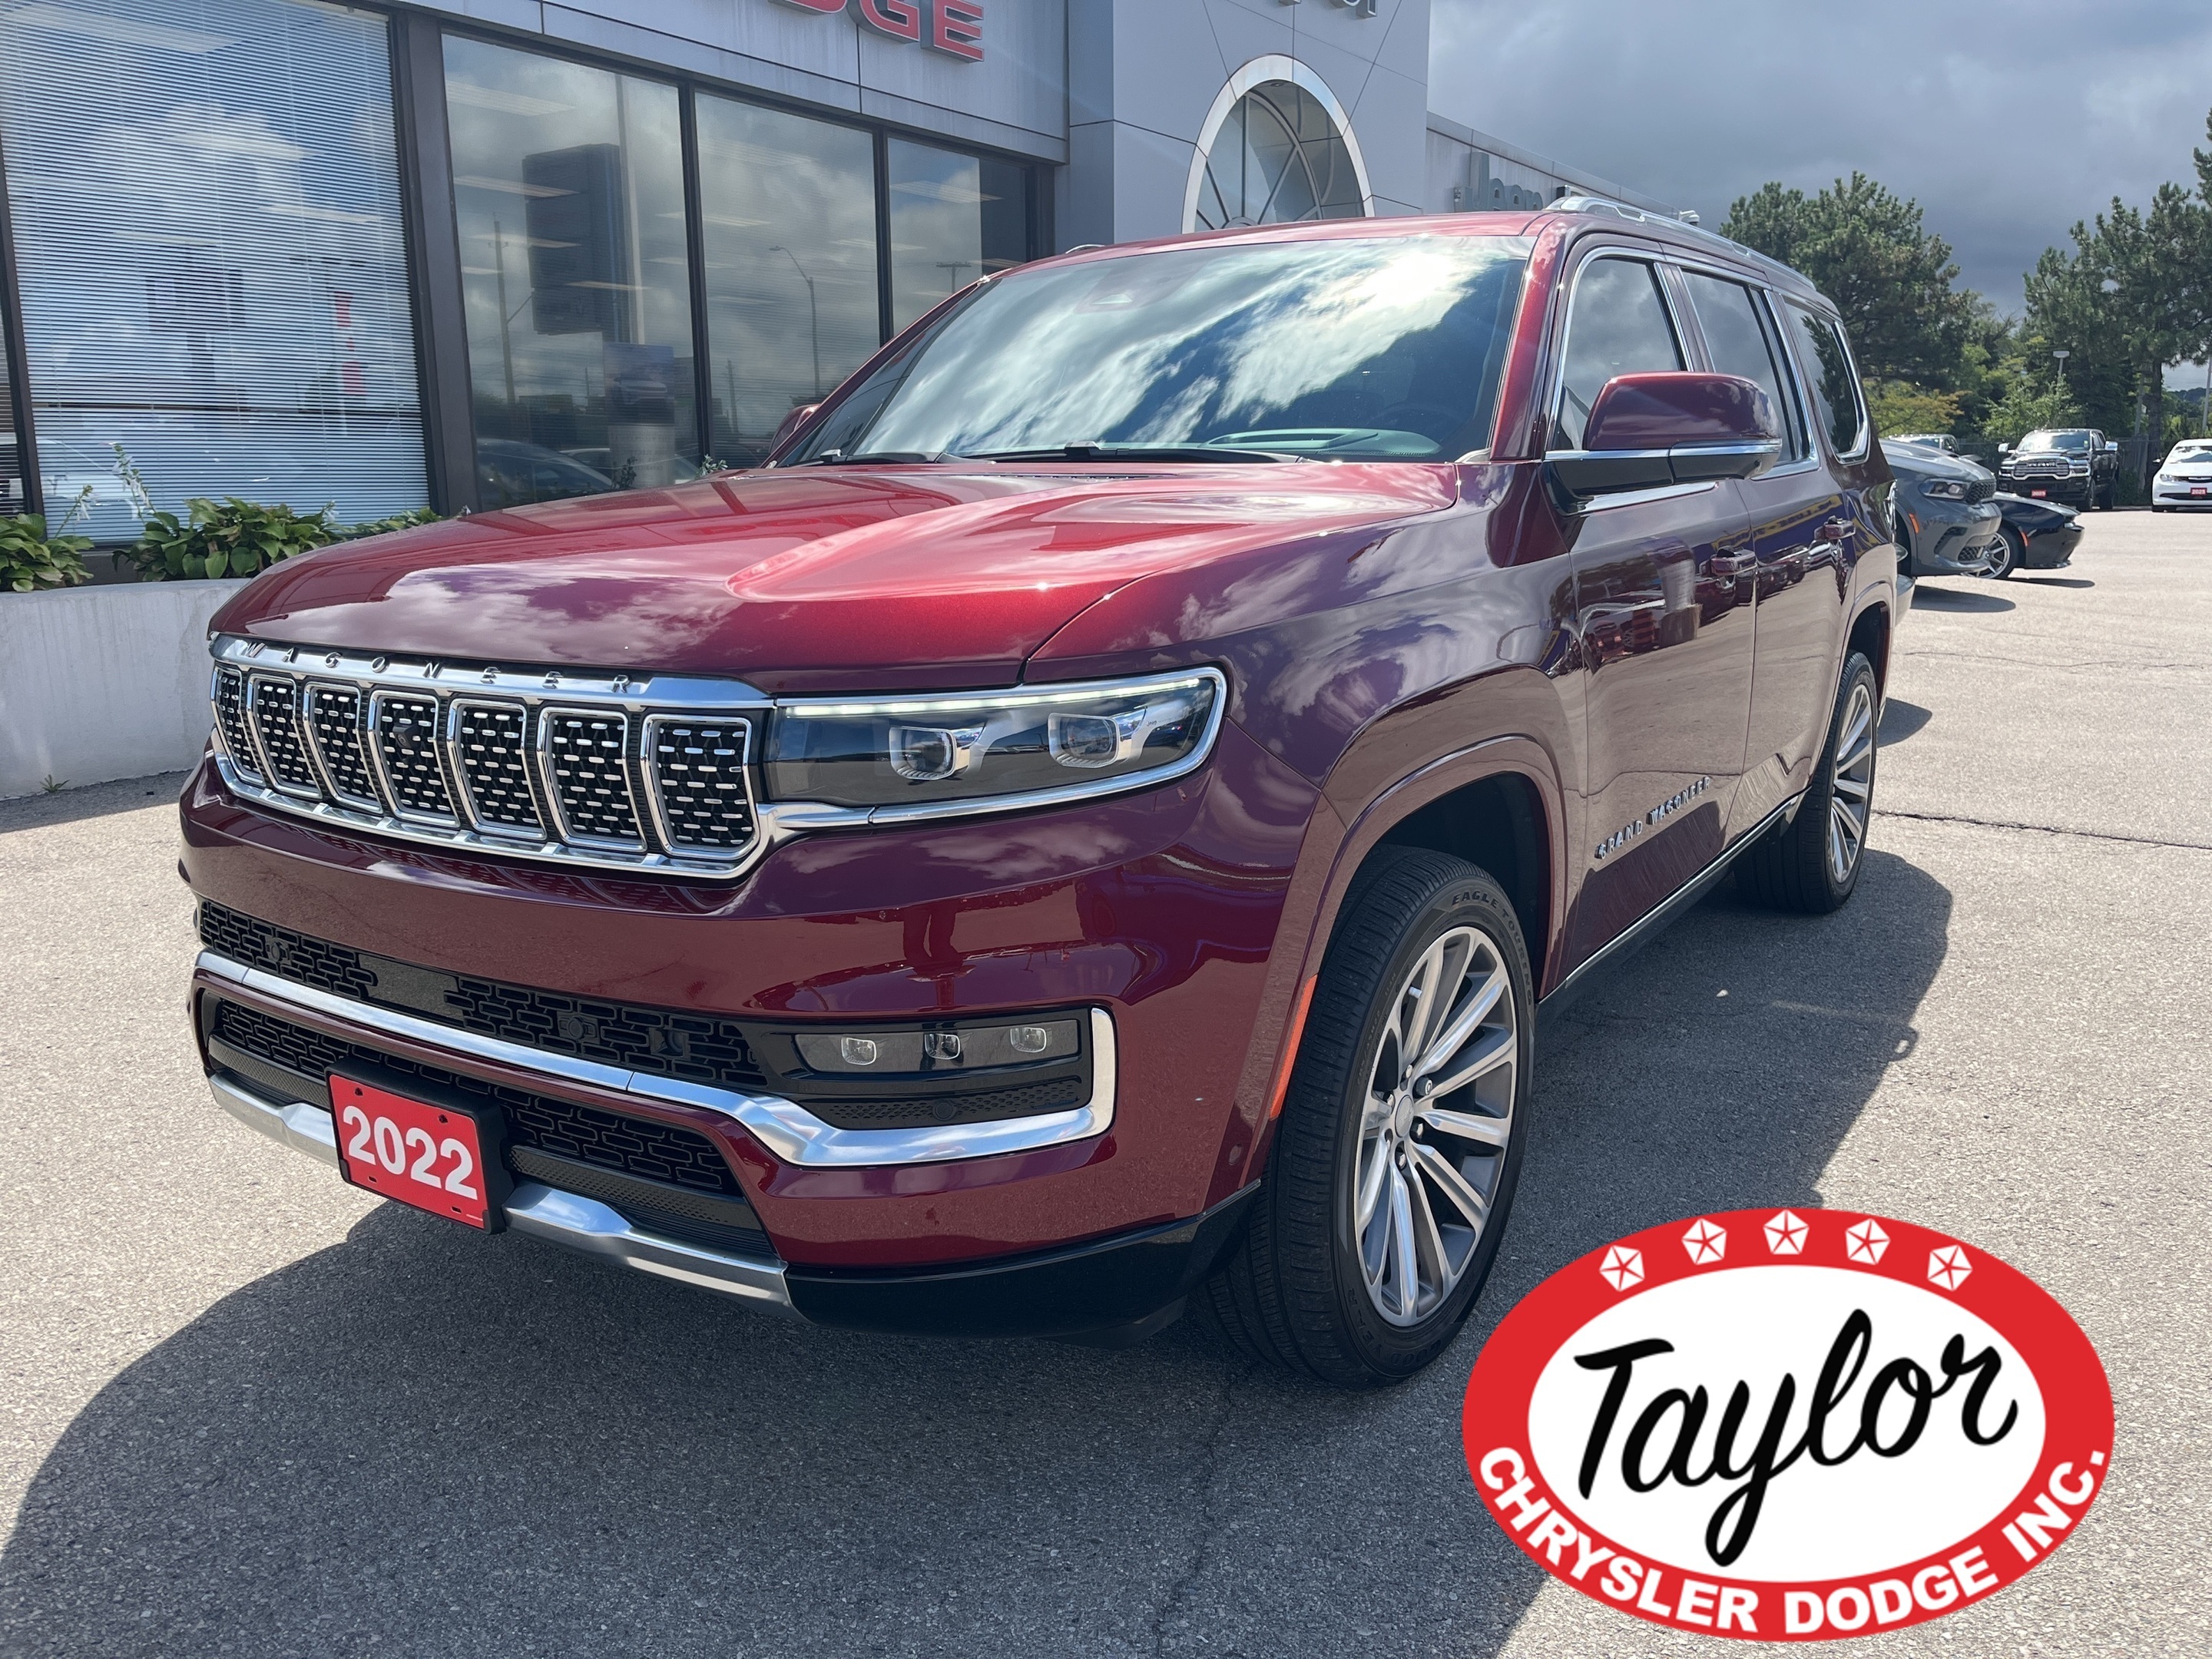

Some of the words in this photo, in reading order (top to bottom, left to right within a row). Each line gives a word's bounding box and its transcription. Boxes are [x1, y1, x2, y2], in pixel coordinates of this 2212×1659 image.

[240, 641, 633, 694] WAGONEER
[1594, 820, 1643, 859] GRAND
[1646, 776, 1711, 826] WAGONEER
[1451, 890, 1500, 909] EAGLE
[1498, 908, 1532, 1006] TOURING
[343, 1105, 478, 1200] 2022
